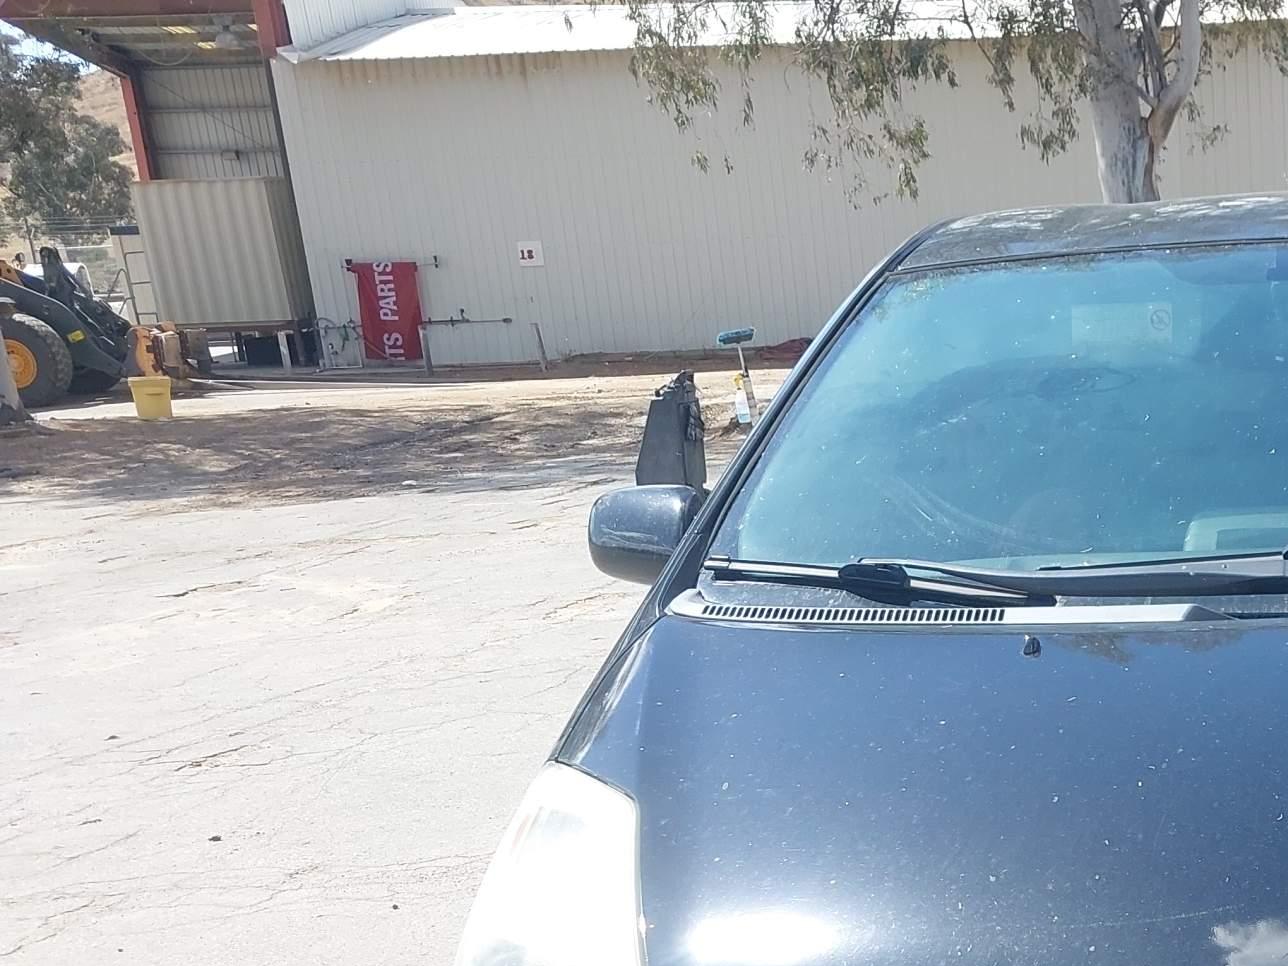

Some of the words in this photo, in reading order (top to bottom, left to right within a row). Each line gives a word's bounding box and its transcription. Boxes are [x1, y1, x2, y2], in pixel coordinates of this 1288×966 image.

[519, 249, 535, 260] 18
[372, 261, 400, 321] PARTS
[383, 332, 406, 361] TS
